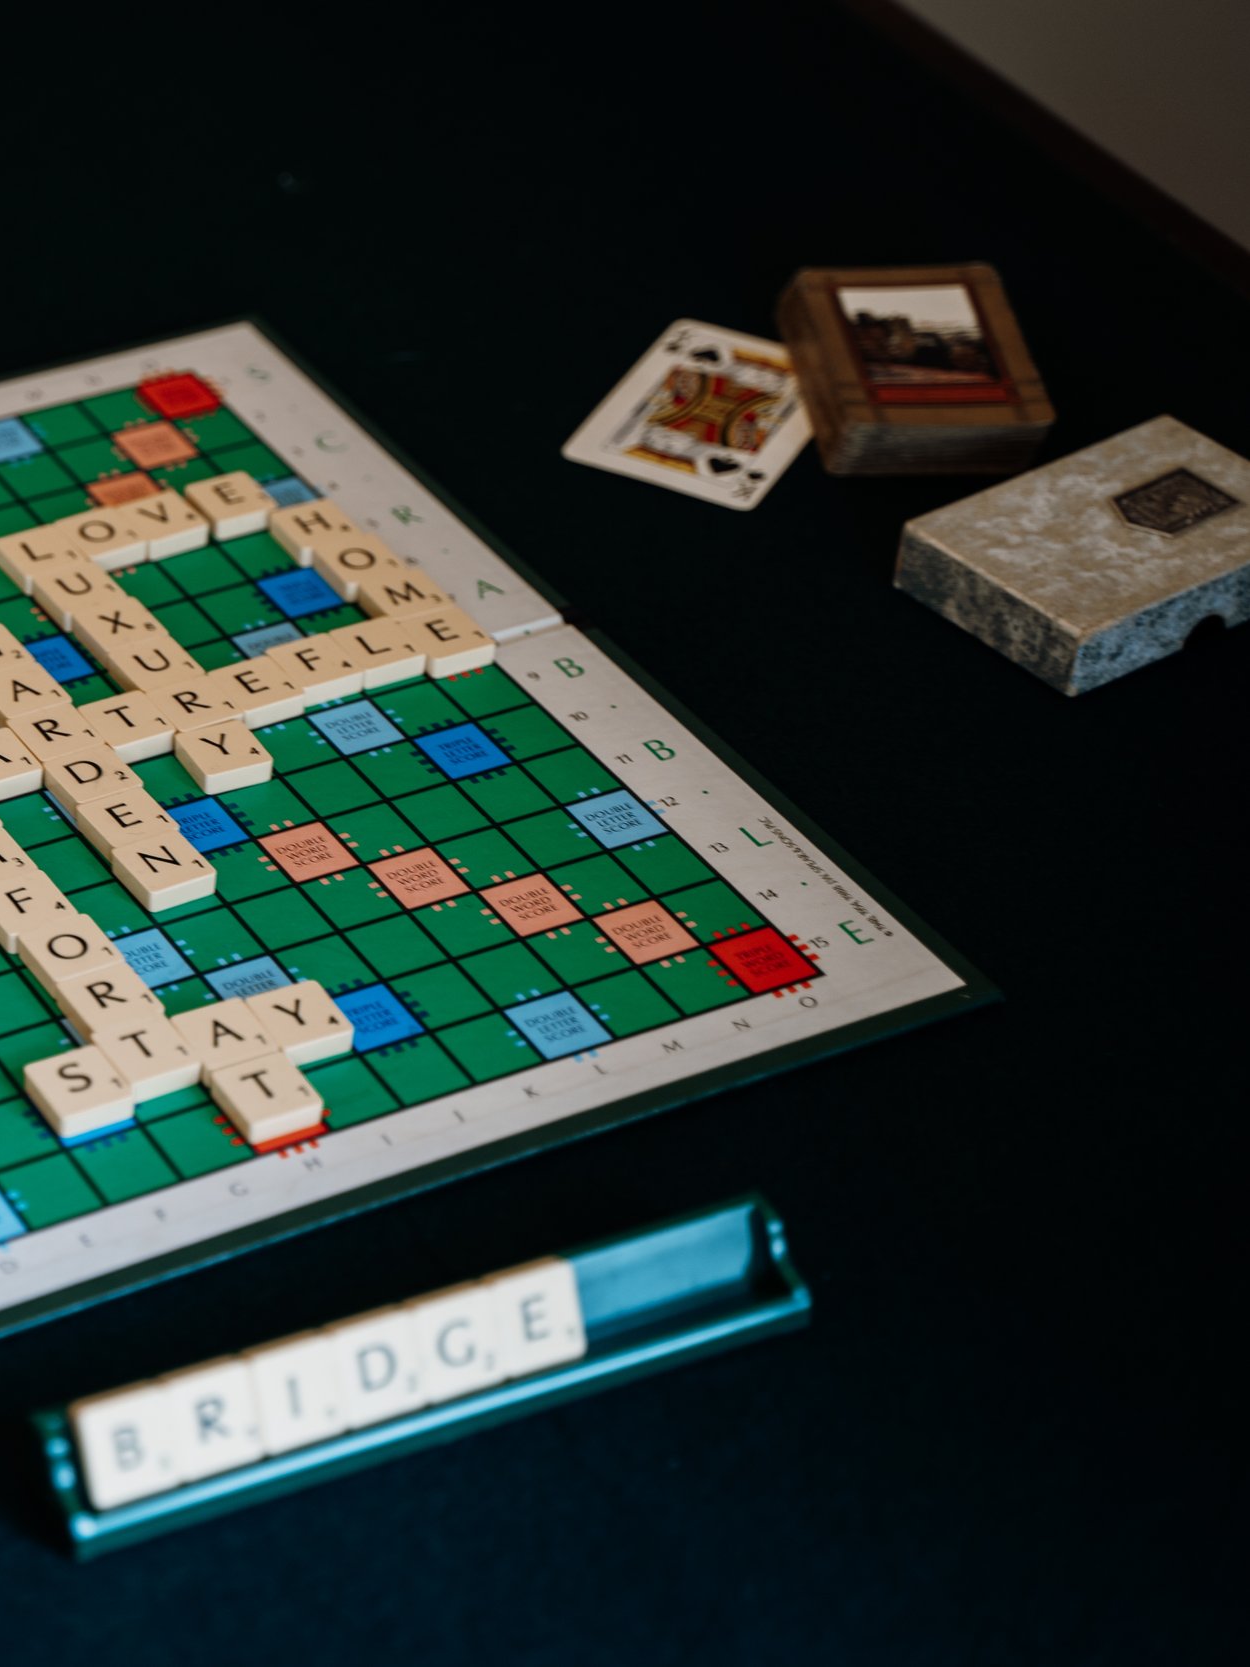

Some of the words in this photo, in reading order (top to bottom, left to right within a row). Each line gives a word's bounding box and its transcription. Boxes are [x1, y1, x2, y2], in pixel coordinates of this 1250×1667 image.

[527, 671, 541, 681] 9
[324, 710, 376, 731] DOUBLE
[569, 710, 589, 722] 10
[335, 718, 379, 736] LETTER
[342, 725, 385, 743] SCORE
[437, 735, 478, 752] TRIPLE
[442, 742, 486, 760] LETTER
[449, 749, 492, 767] SCORE
[615, 753, 634, 764] 11
[658, 795, 679, 807] 12
[583, 801, 636, 823] DOUBLE
[595, 809, 639, 828] LETTER
[603, 817, 646, 836] SCORE
[275, 833, 329, 856] DOUBLE
[708, 841, 729, 854] 13
[768, 827, 798, 849] SONS
[287, 842, 332, 861] WORD
[293, 850, 338, 869] SCORE
[385, 859, 439, 882] DOUBLE
[397, 868, 442, 887] WORD
[404, 876, 449, 895] SCORE
[758, 888, 779, 900] 14
[497, 886, 551, 908] DOUBLE
[509, 895, 555, 914] WORD
[517, 902, 562, 922] SCORE
[611, 912, 666, 936] DOUBLE
[624, 922, 669, 942] WORD
[632, 929, 677, 950] SCORE
[809, 936, 830, 948] 15
[121, 941, 165, 961] OUBLE
[126, 950, 167, 969] ETTER
[133, 959, 173, 977] CORE
[222, 969, 278, 993] DOUBLE
[234, 978, 281, 999] LETTER
[797, 994, 819, 1008] O
[522, 1004, 579, 1029] DOUBLE
[535, 1014, 582, 1035] LETTER
[731, 1016, 751, 1030] N
[543, 1022, 589, 1044] SCORE
[660, 1039, 683, 1053] M
[594, 1063, 608, 1075] L
[523, 1086, 539, 1098] K
[111, 1293, 551, 1472] BRIDGE
